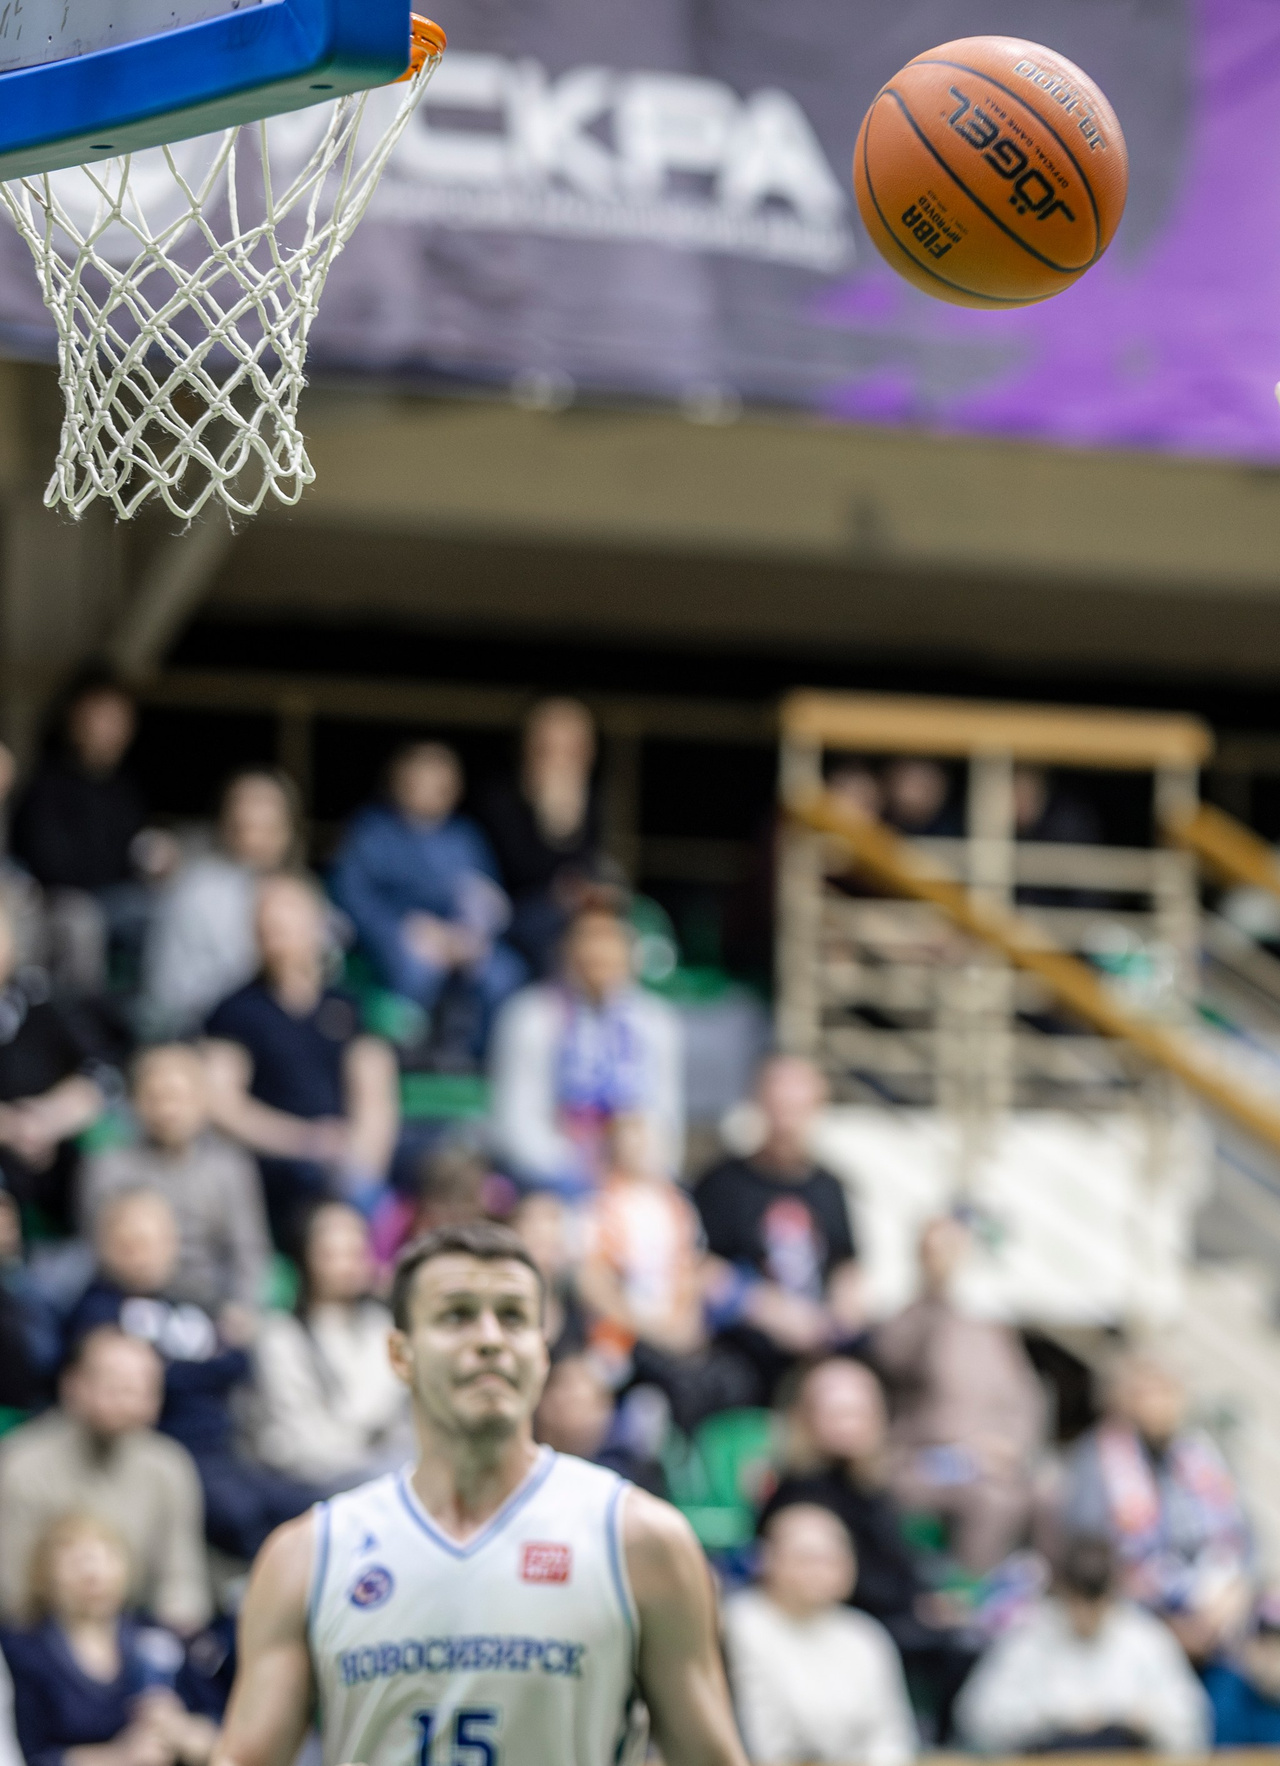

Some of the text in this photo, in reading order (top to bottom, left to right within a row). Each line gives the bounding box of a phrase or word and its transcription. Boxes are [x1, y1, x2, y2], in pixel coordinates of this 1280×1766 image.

[947, 84, 1076, 223] JÖGEL
[985, 96, 1070, 189] OFFICIAL GAME BALL
[901, 204, 953, 260] FIBA
[918, 195, 962, 244] APPROVED
[414, 1707, 500, 1766] 15
